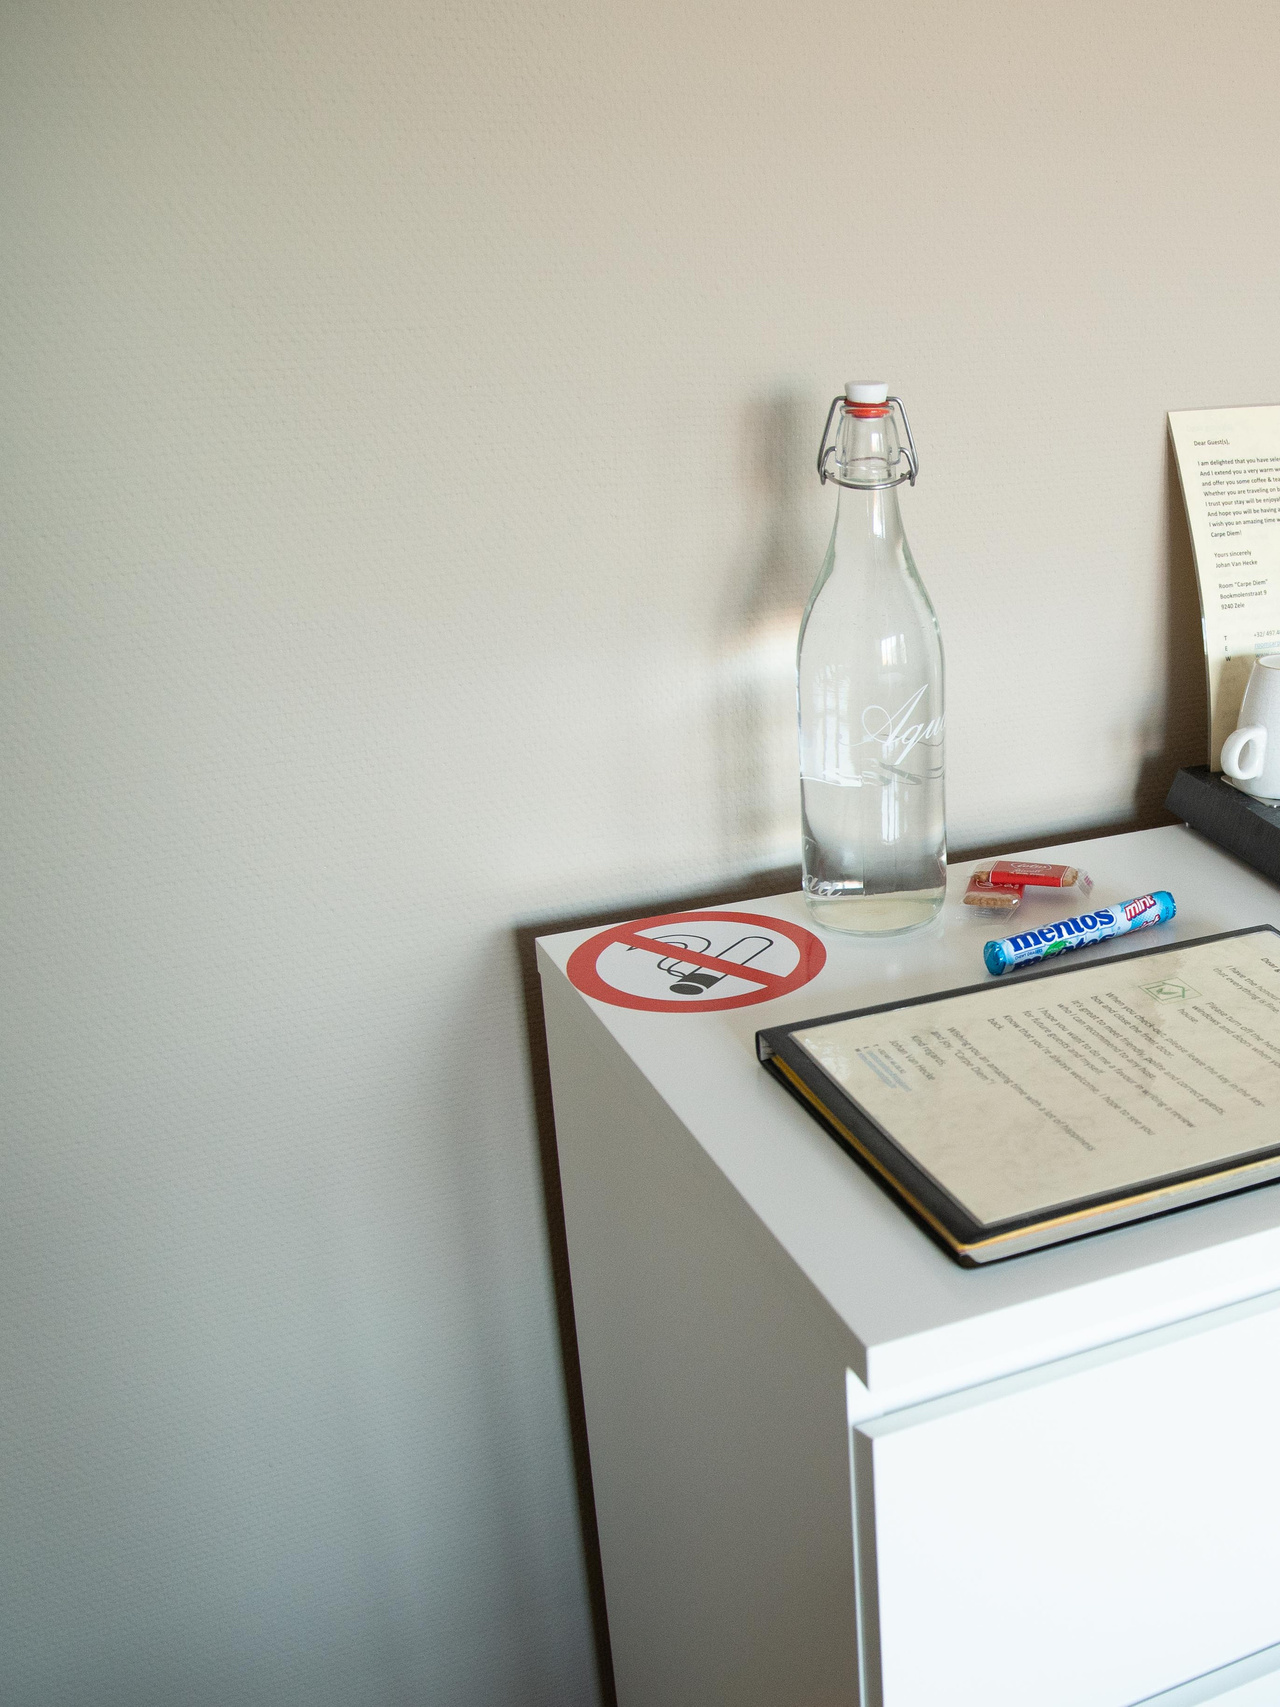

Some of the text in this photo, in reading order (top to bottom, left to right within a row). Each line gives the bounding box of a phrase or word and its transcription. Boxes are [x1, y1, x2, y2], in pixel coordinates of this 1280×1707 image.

[1220, 591, 1262, 599] Bookmolenstraat
[1124, 894, 1157, 921] mint
[1007, 909, 1115, 951] mentos
